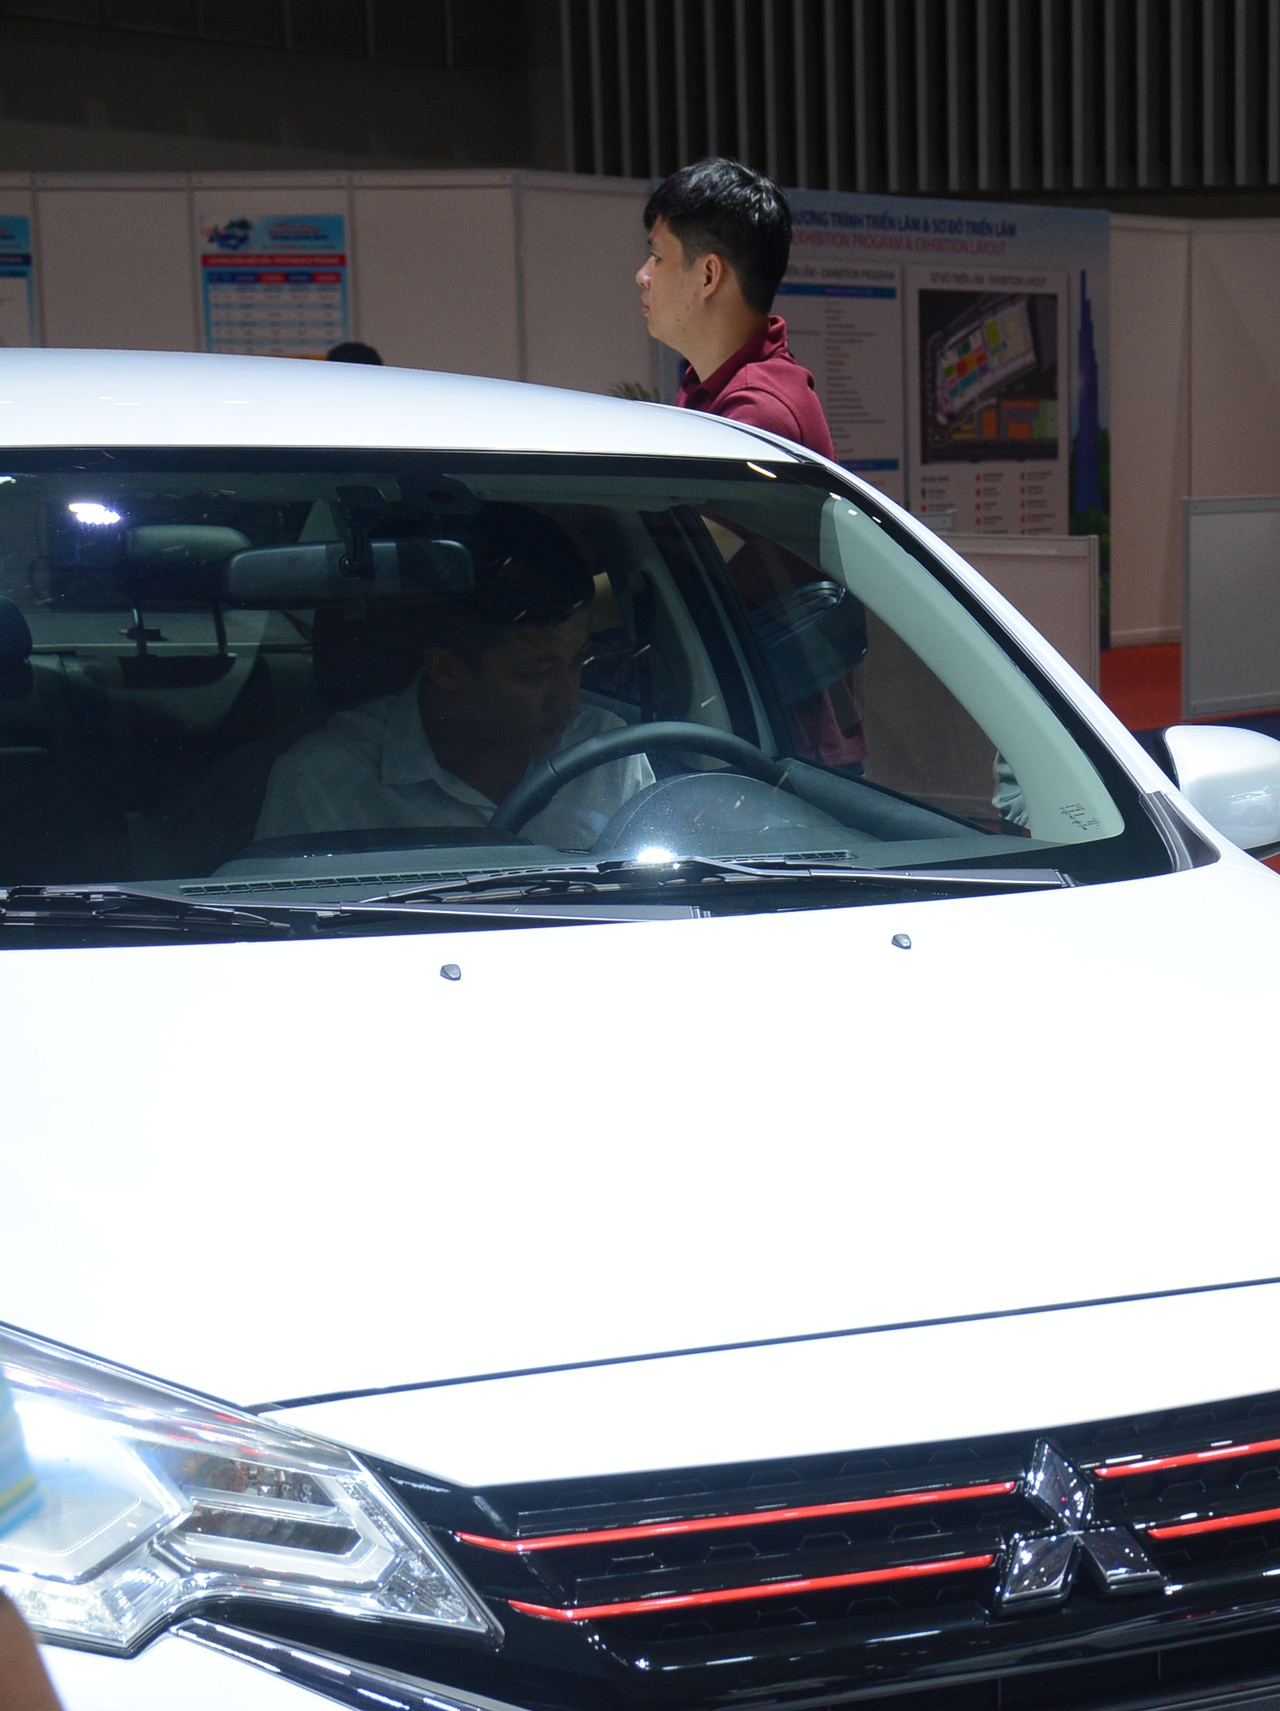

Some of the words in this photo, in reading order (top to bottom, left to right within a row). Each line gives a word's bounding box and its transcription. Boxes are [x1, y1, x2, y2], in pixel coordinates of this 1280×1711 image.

[852, 233, 903, 251] PROGRAM
[915, 238, 969, 254] EXHIBITION
[970, 240, 1006, 255] LAYOUT
